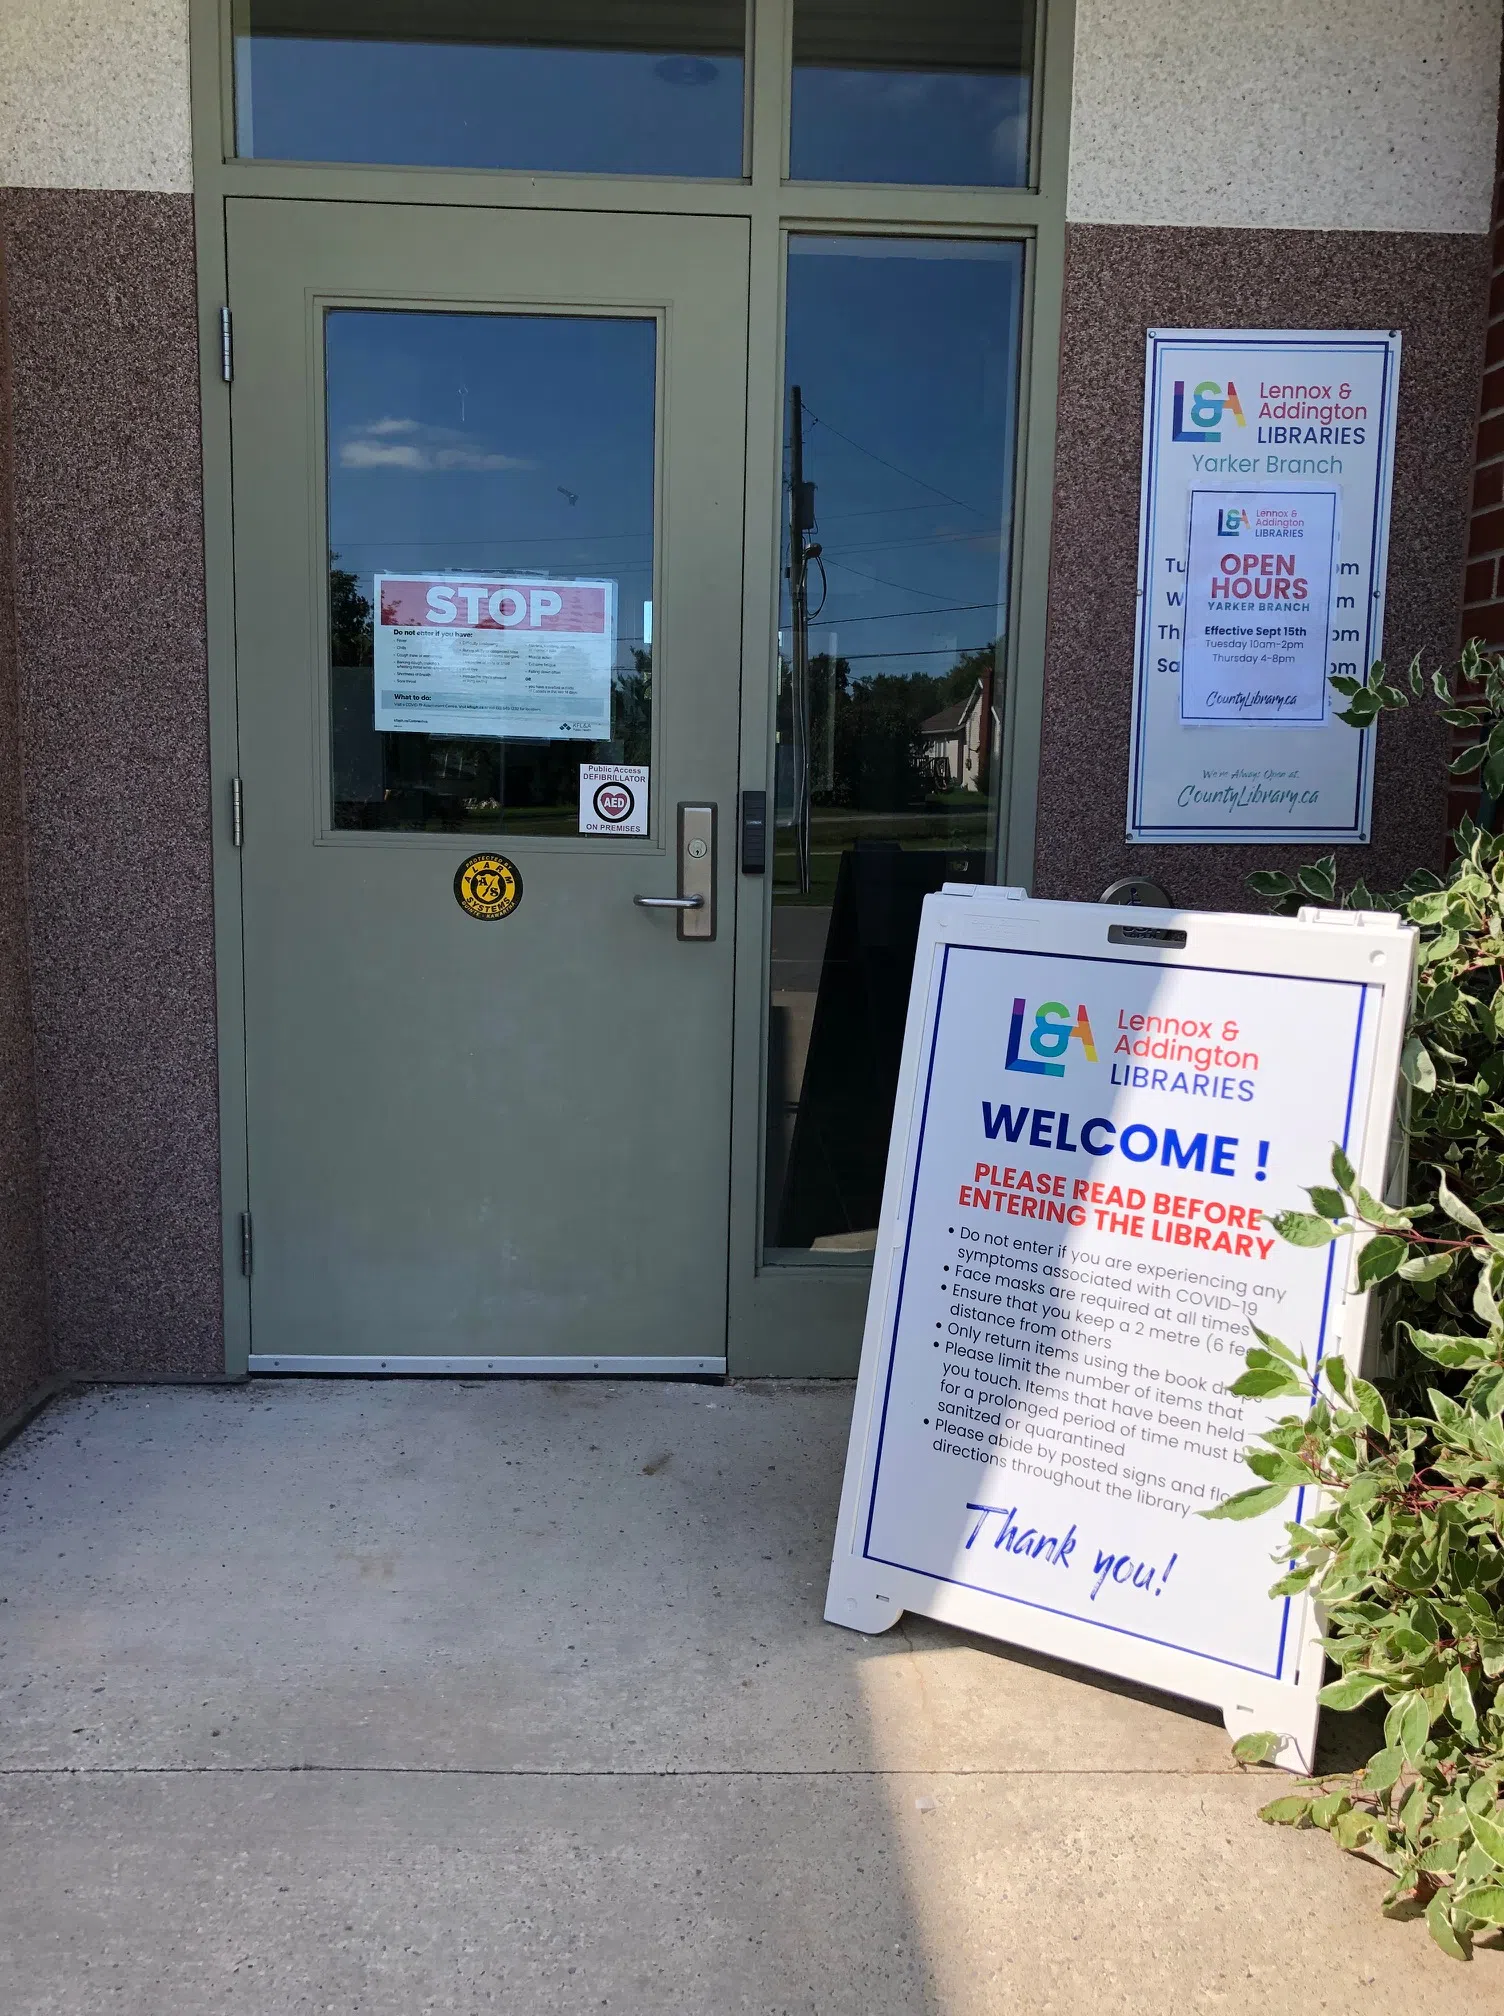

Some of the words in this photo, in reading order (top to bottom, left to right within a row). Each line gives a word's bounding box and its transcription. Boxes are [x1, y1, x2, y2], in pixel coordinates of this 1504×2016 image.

[1260, 382, 1332, 399] Lennox
[1339, 383, 1352, 399] &
[1259, 402, 1367, 425] Addington
[1258, 427, 1365, 444] LIBRARIES
[1192, 454, 1260, 473] Yarker
[1266, 456, 1343, 474] Branch
[1255, 529, 1303, 537] LIBRARIES
[1256, 518, 1304, 528] Addington
[1220, 554, 1295, 576] OPEN
[1212, 578, 1308, 599] HOURS
[426, 586, 562, 626] STOP
[1208, 602, 1254, 611] YARKER
[1259, 602, 1310, 612] BRANCH
[1205, 626, 1253, 636] Effective
[1256, 627, 1281, 638] Sept
[1283, 627, 1306, 637] 15th
[1206, 640, 1247, 650] Tuesday
[1213, 654, 1258, 664] Thursday
[1206, 691, 1296, 710] CountyLibrary.ca
[584, 774, 645, 782] DEFIBRILLATOR
[604, 798, 624, 807] AED
[1178, 784, 1319, 813] CountyLibrary.ca
[465, 862, 513, 884] ALARM
[466, 856, 502, 867] PROTECTED
[467, 897, 510, 912] SYSTEMS
[1118, 1009, 1212, 1038] Lennox
[1221, 1020, 1239, 1041] &
[1114, 1035, 1259, 1070] Addington
[1110, 1063, 1254, 1102] LIBRARIES
[982, 1100, 1239, 1177] WELCOME
[974, 1162, 1067, 1197] PLEASE
[1072, 1179, 1145, 1210] READ
[1153, 1193, 1263, 1231] BEFORE
[959, 1185, 1086, 1226] ENTERING
[1094, 1209, 1145, 1238] THE
[1152, 1220, 1275, 1260] LIBRARY
[960, 1227, 979, 1241] Do
[984, 1233, 1009, 1247] not
[1013, 1239, 1053, 1258] enter
[1058, 1245, 1067, 1258] if
[1071, 1250, 1100, 1265] you
[1105, 1257, 1132, 1270] are
[1137, 1264, 1247, 1297] experiencing
[1253, 1285, 1287, 1303] any
[957, 1248, 1038, 1273] symptoms
[1043, 1264, 1132, 1292] associated
[1137, 1282, 1171, 1299] with
[1176, 1289, 1258, 1316] COVID-19
[955, 1265, 990, 1283] Face
[995, 1274, 1045, 1294] masks
[1050, 1286, 1076, 1300] are
[1081, 1293, 1150, 1316] required
[1154, 1306, 1172, 1320] at
[1176, 1310, 1196, 1325] all
[1202, 1314, 1250, 1336] times
[950, 1304, 1015, 1327] distance
[1020, 1318, 1056, 1338] from
[1061, 1328, 1112, 1349] others
[952, 1284, 1002, 1305] Ensure
[1006, 1295, 1038, 1313] that
[1042, 1304, 1071, 1319] you
[1076, 1310, 1114, 1332] keep
[1120, 1322, 1130, 1332] a
[1135, 1322, 1144, 1336] 2
[1150, 1327, 1200, 1347] metre
[1206, 1333, 1224, 1353] (6
[948, 1322, 981, 1343] Only
[985, 1332, 1031, 1352] return
[1035, 1340, 1079, 1362] items
[1084, 1354, 1128, 1377] using
[1133, 1363, 1160, 1380] the
[1165, 1369, 1207, 1392] book
[945, 1341, 994, 1363] Please
[998, 1353, 1032, 1372] limit
[1036, 1362, 1060, 1378] the
[1065, 1370, 1130, 1394] number
[1135, 1385, 1150, 1399] of
[1156, 1388, 1202, 1411] items
[1208, 1400, 1244, 1421] that
[943, 1362, 969, 1376] you
[974, 1369, 1020, 1390] touch.
[1026, 1380, 1068, 1401] Items
[1074, 1392, 1107, 1410] that
[1112, 1400, 1153, 1421] have
[1158, 1410, 1201, 1433] been
[1207, 1422, 1244, 1442] held
[938, 1401, 1001, 1426] sanitzed
[1005, 1418, 1020, 1430] or
[1025, 1422, 1125, 1456] quarantined
[940, 1379, 960, 1395] for
[964, 1388, 974, 1399] a
[978, 1391, 1058, 1418] prolonged
[1062, 1411, 1115, 1433] period
[1120, 1425, 1136, 1438] of
[1141, 1428, 1178, 1448] time
[1184, 1439, 1228, 1460] must
[935, 1418, 984, 1442] Please
[988, 1434, 1033, 1454] abide
[1037, 1443, 1056, 1464] by
[1061, 1452, 1118, 1476] posted
[1123, 1466, 1166, 1488] signs
[1171, 1479, 1205, 1497] and
[933, 1439, 1006, 1468] directions
[1012, 1458, 1102, 1493] throughout
[1106, 1482, 1132, 1500] the
[1137, 1489, 1190, 1518] library
[966, 1503, 1077, 1568] Thank
[1091, 1549, 1178, 1600] you!
